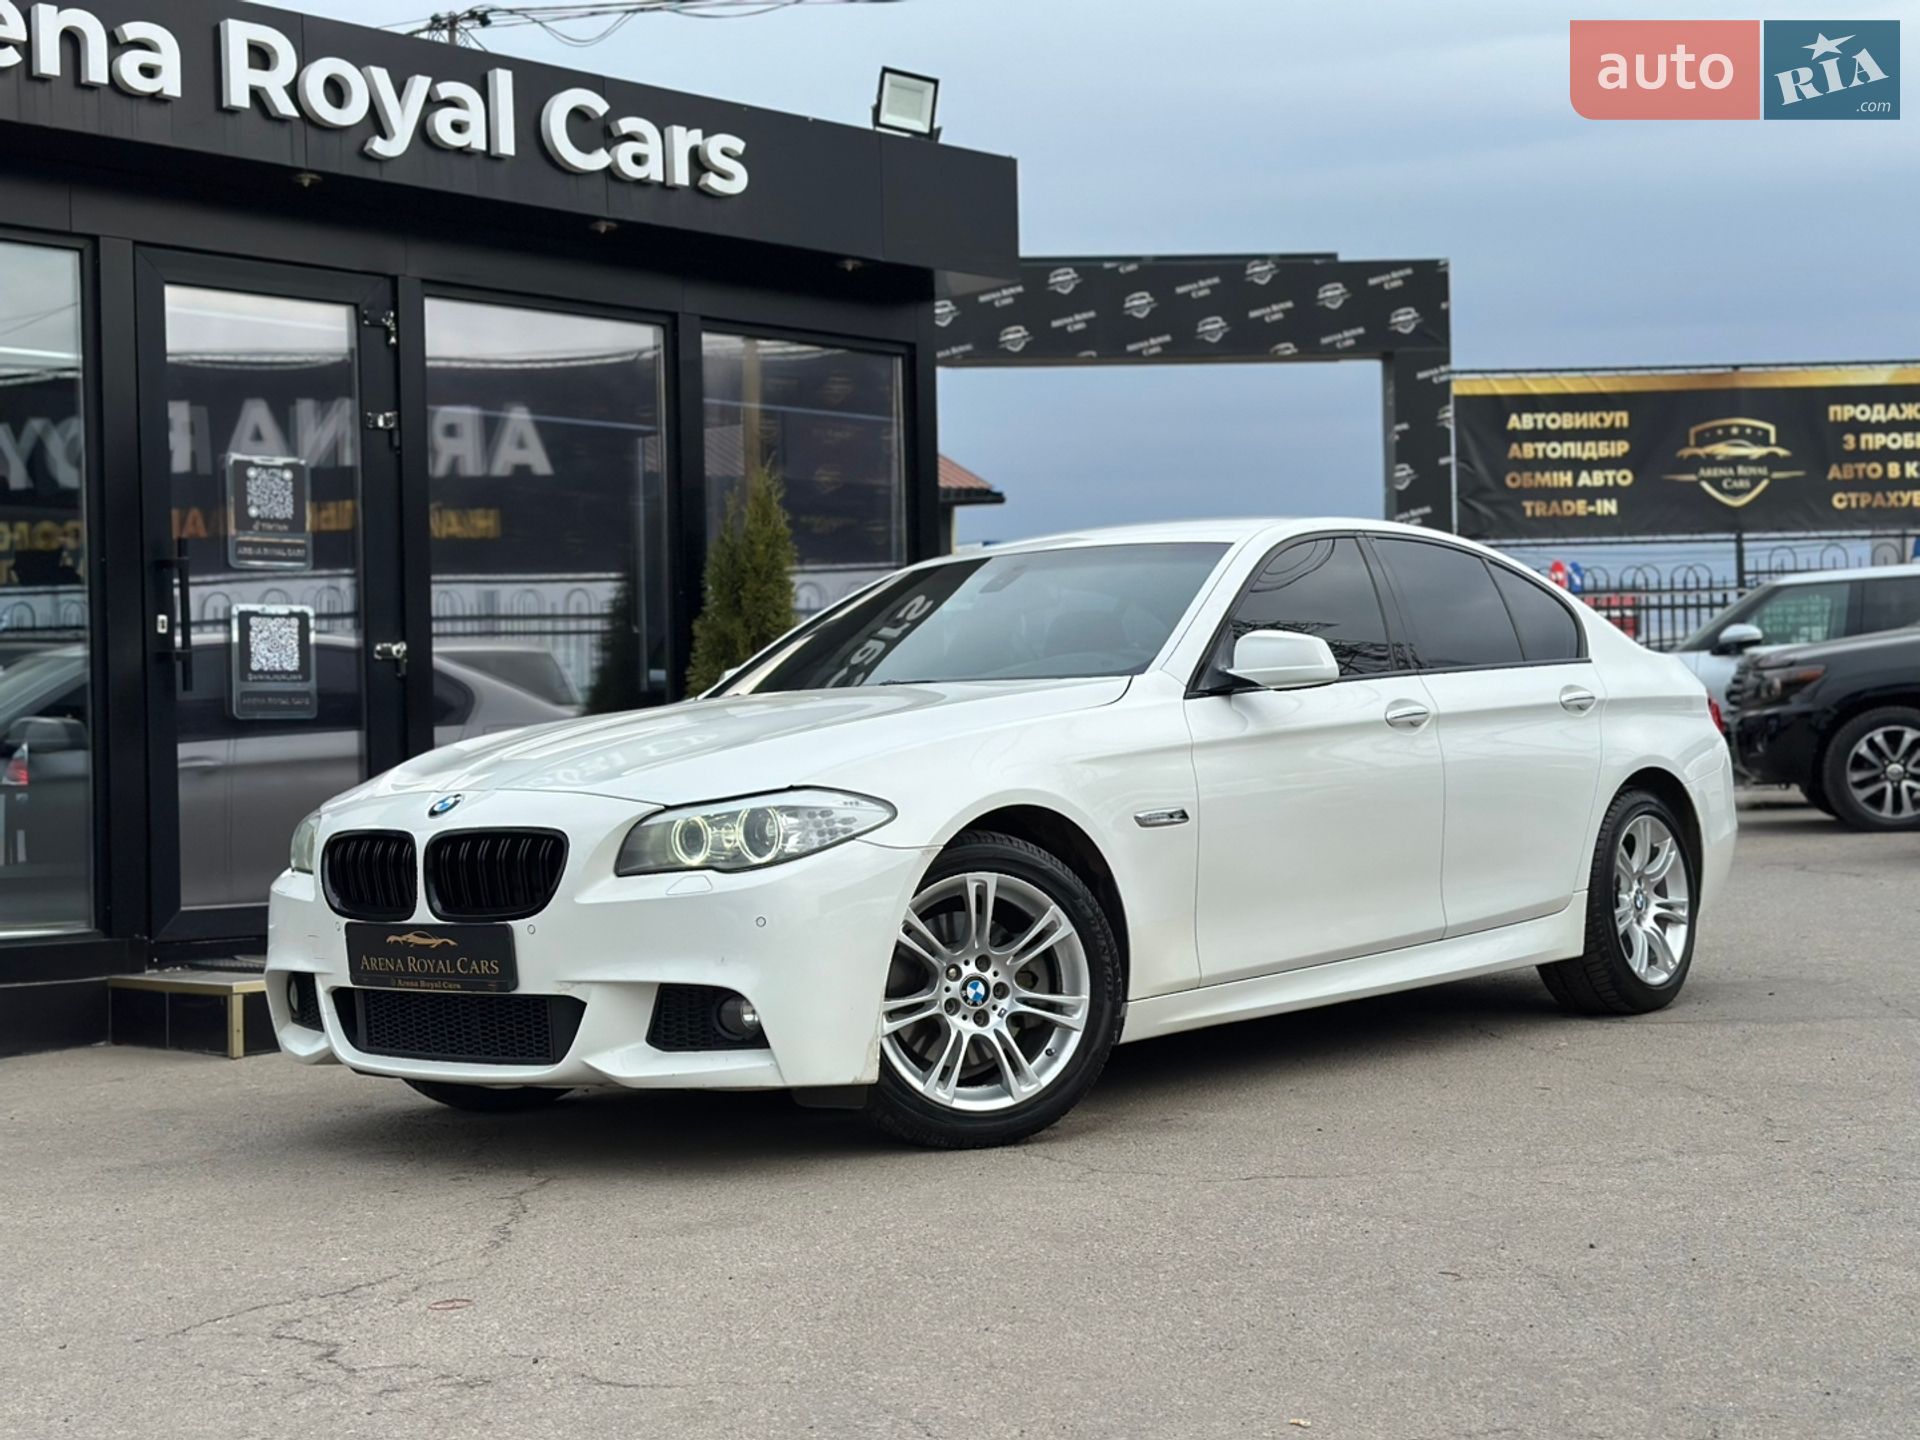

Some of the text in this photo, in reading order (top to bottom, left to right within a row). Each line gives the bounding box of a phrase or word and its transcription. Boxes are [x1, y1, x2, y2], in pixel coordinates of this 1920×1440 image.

[219, 18, 516, 160] Royal
[541, 87, 748, 196] Cars
[1506, 411, 1629, 430] АВТОВИКУП
[1507, 440, 1630, 460] АВТОПІДБІР
[1505, 469, 1633, 488] ОБМІН АВТО
[1827, 461, 1883, 480] АВТО
[1522, 498, 1618, 517] TRADE-IN
[360, 954, 501, 975] ARENA ROYAL CARS
